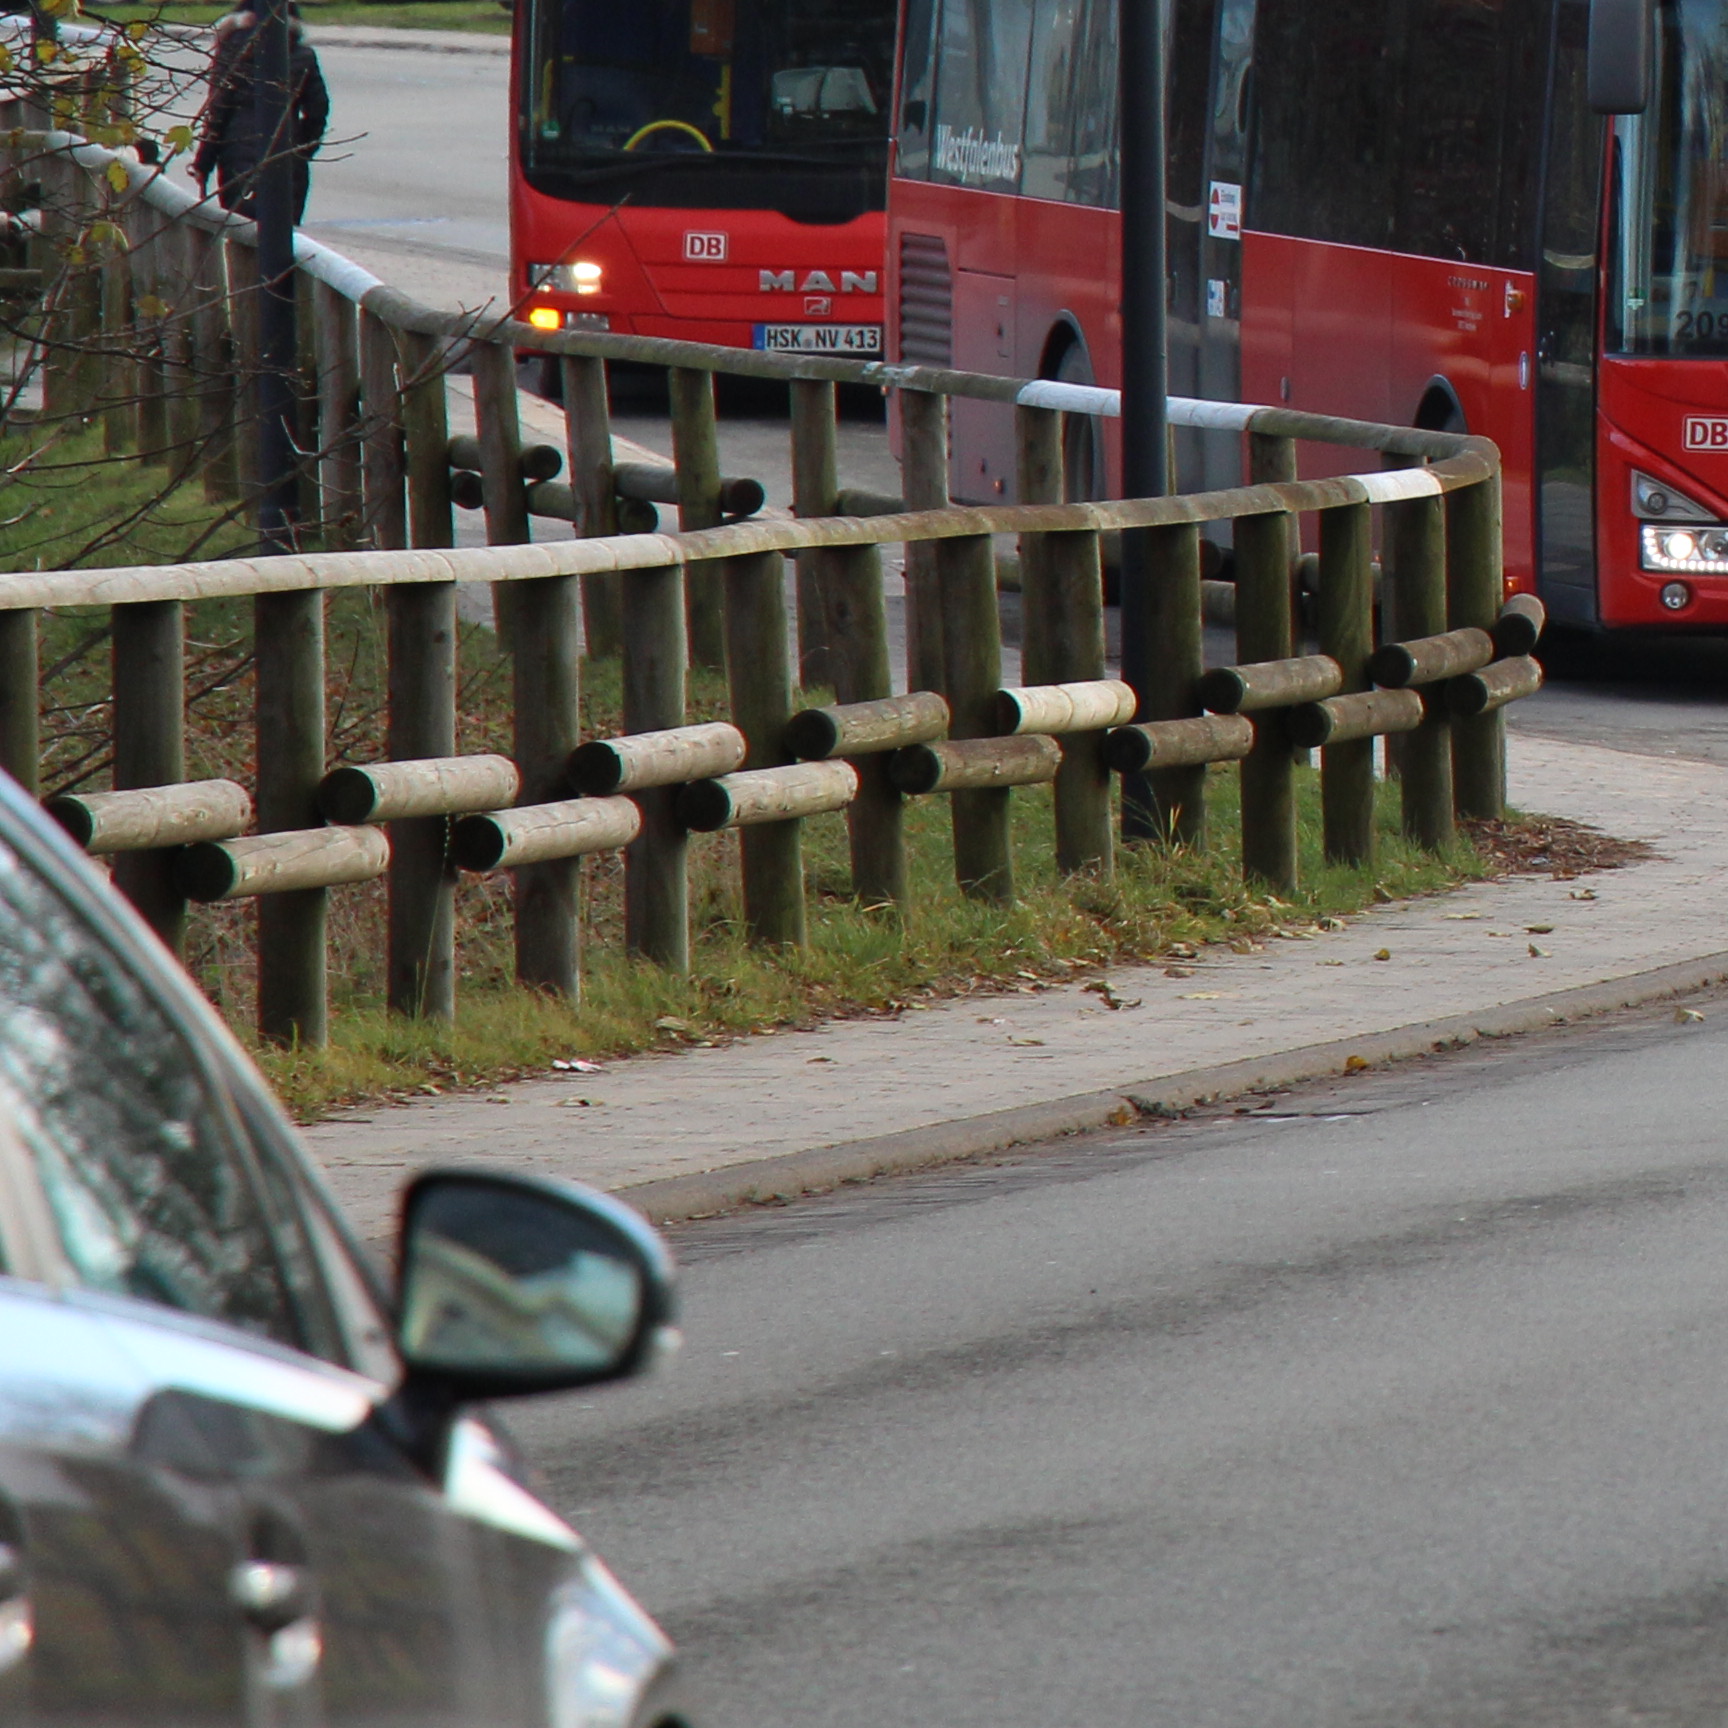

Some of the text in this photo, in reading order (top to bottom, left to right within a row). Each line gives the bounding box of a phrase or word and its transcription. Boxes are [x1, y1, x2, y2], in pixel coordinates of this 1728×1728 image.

[689, 236, 722, 256] DB
[759, 270, 878, 293] MAN
[766, 328, 878, 349] HSK NV 413
[1689, 421, 1728, 447] DB
